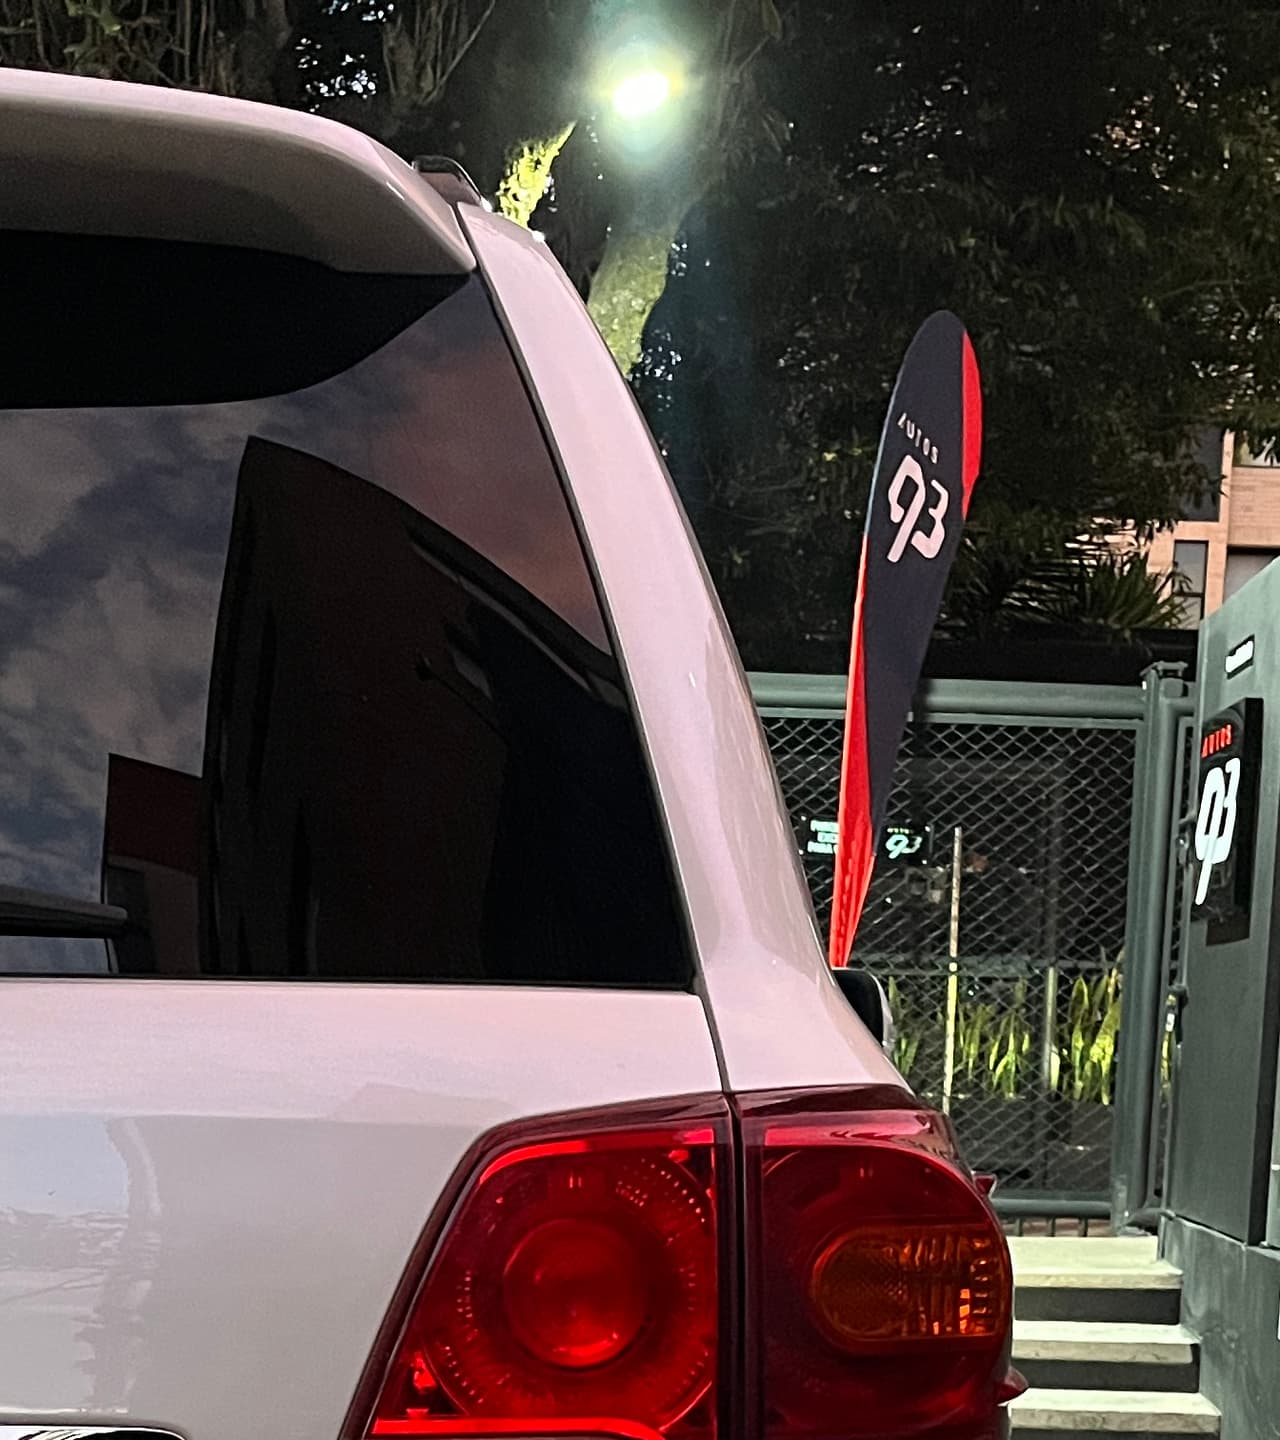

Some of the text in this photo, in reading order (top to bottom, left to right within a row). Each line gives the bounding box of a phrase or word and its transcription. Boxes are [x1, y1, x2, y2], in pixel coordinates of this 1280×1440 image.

[897, 412, 939, 465] AUTOS
[886, 453, 950, 564] 93
[1194, 757, 1241, 906] 93
